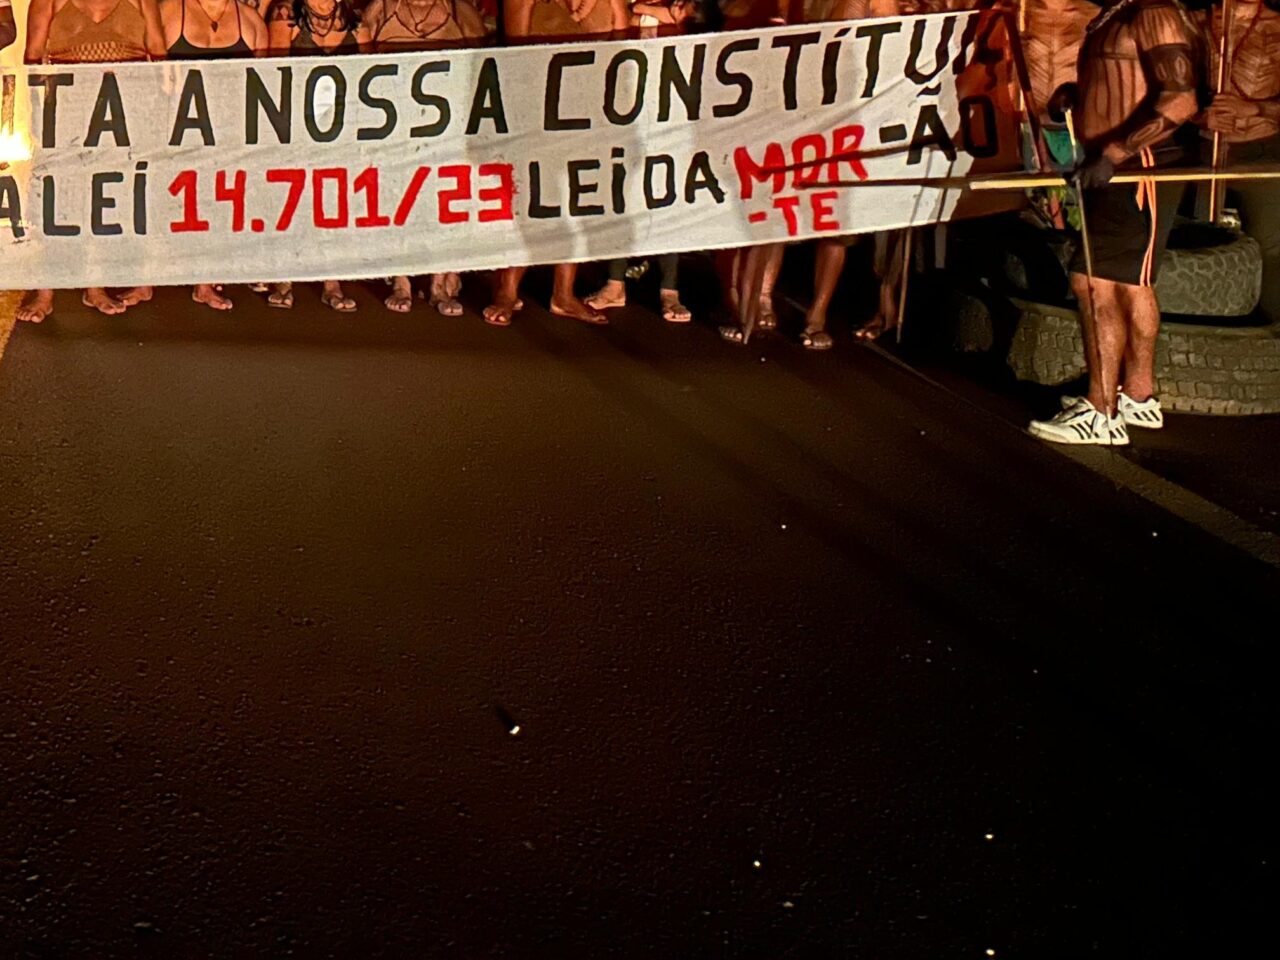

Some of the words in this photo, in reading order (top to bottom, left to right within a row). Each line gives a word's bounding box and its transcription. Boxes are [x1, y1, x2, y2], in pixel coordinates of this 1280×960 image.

[168, 69, 216, 146] A
[245, 56, 508, 145] NOSSA
[167, 163, 514, 233] 14.701/23
[733, 124, 868, 201] MOR
[748, 190, 840, 237] -TE
